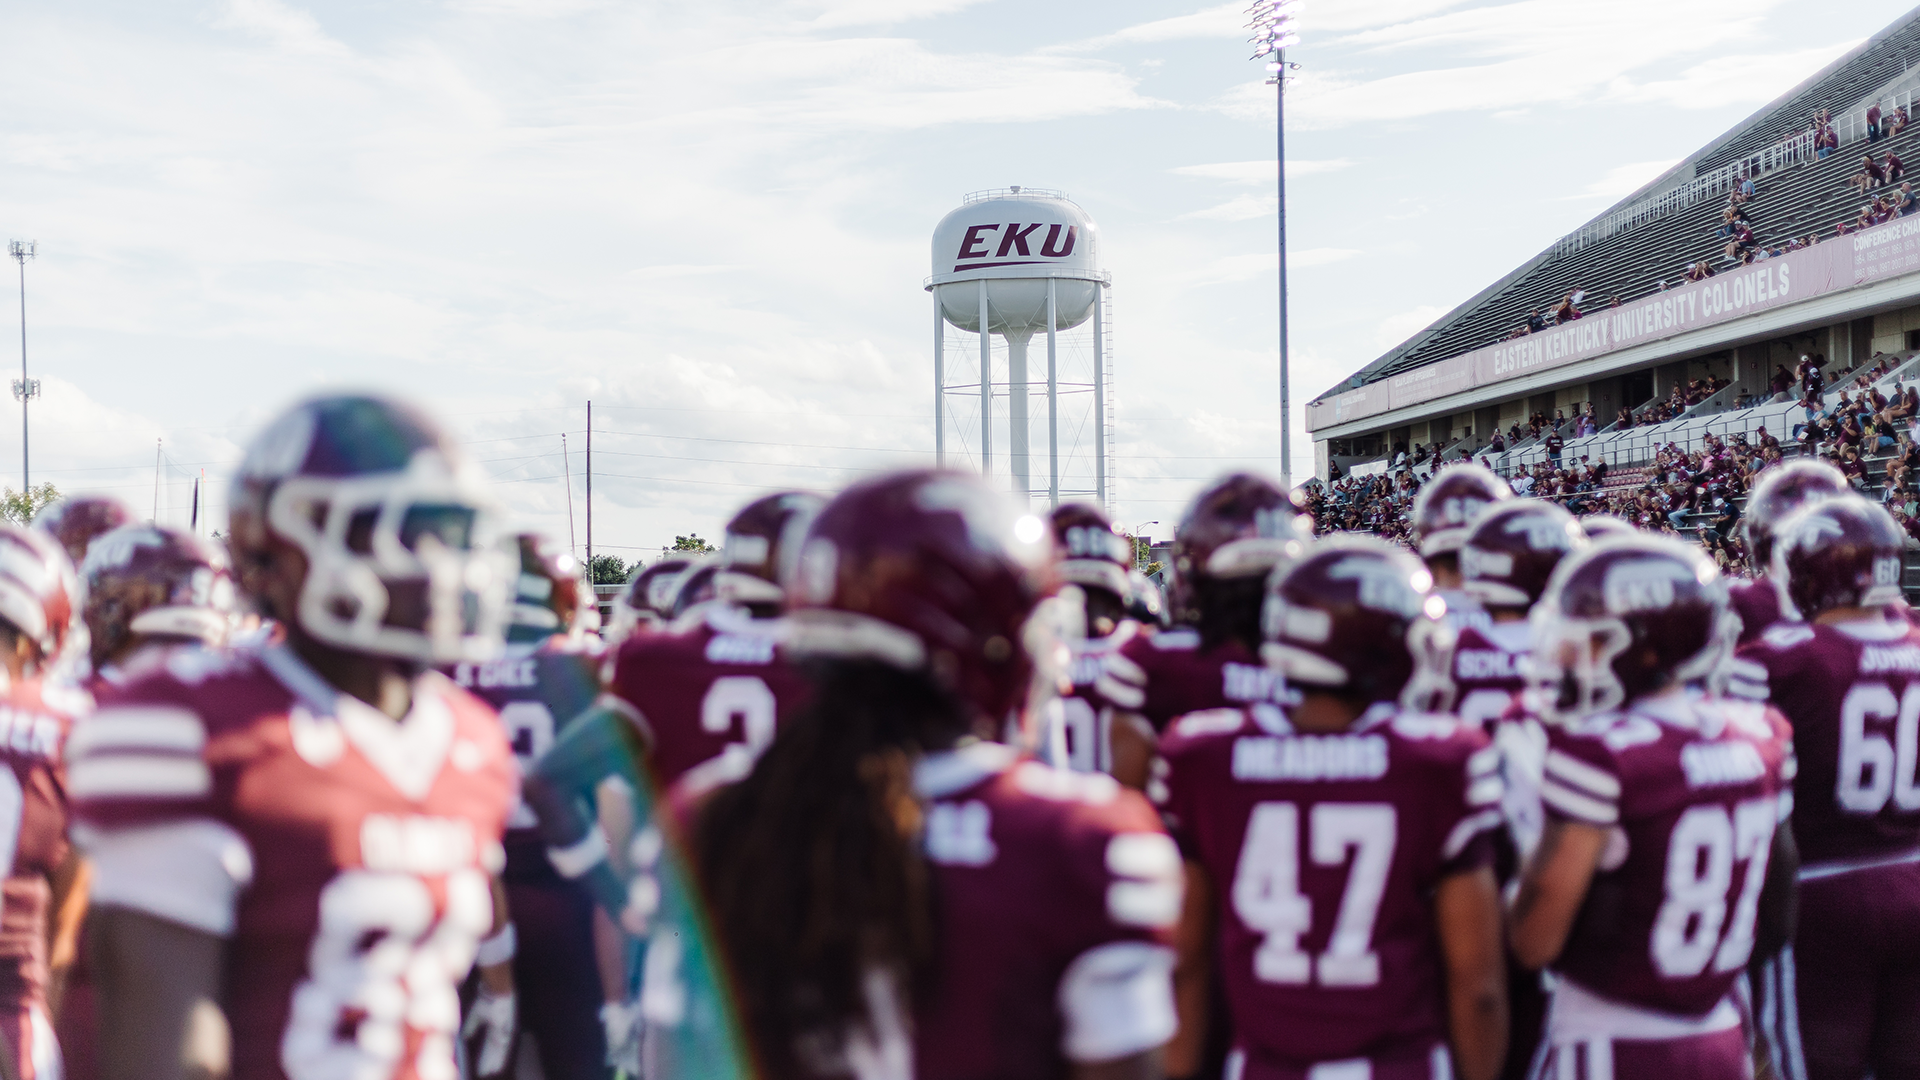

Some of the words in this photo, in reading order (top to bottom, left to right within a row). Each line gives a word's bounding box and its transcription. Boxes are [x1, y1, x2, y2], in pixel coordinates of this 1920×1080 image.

[957, 223, 1078, 259] EKU
[1854, 224, 1901, 251] CONFERENCE
[1494, 338, 1543, 375] EASTERN
[1546, 318, 1608, 361] KENTUCKY
[1613, 290, 1696, 343] UNIVERSITY
[1702, 262, 1790, 318] COLONELS
[1231, 800, 1398, 986] 47
[1650, 798, 1778, 978] 87
